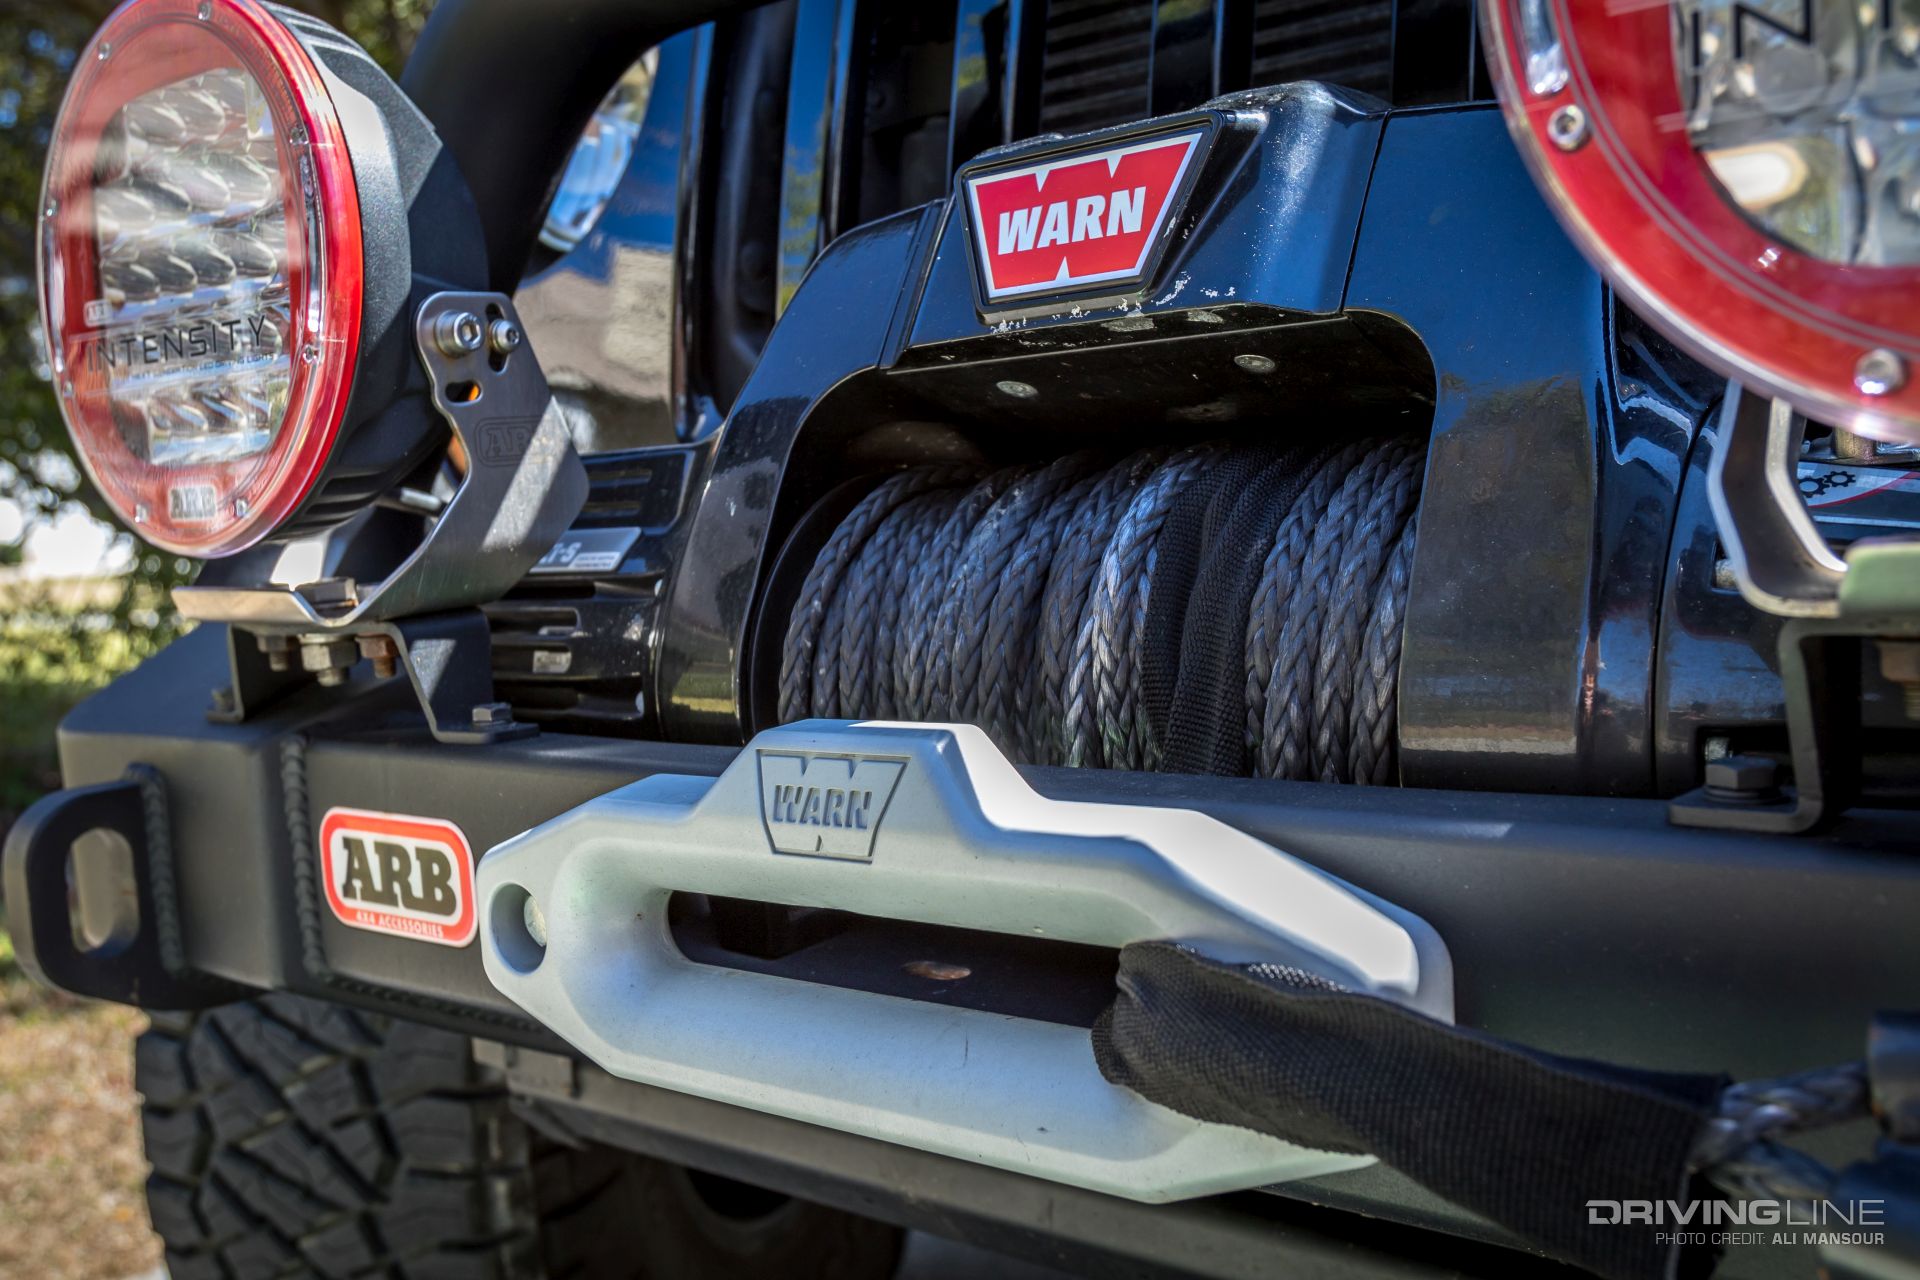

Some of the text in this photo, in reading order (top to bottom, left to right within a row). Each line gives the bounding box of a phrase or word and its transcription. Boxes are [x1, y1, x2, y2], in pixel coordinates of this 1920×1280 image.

[998, 186, 1147, 256] WARN
[86, 315, 266, 375] INTENSITY
[772, 784, 873, 830] WARN
[342, 836, 457, 917] ARB
[378, 915, 444, 939] ACCESSORIES
